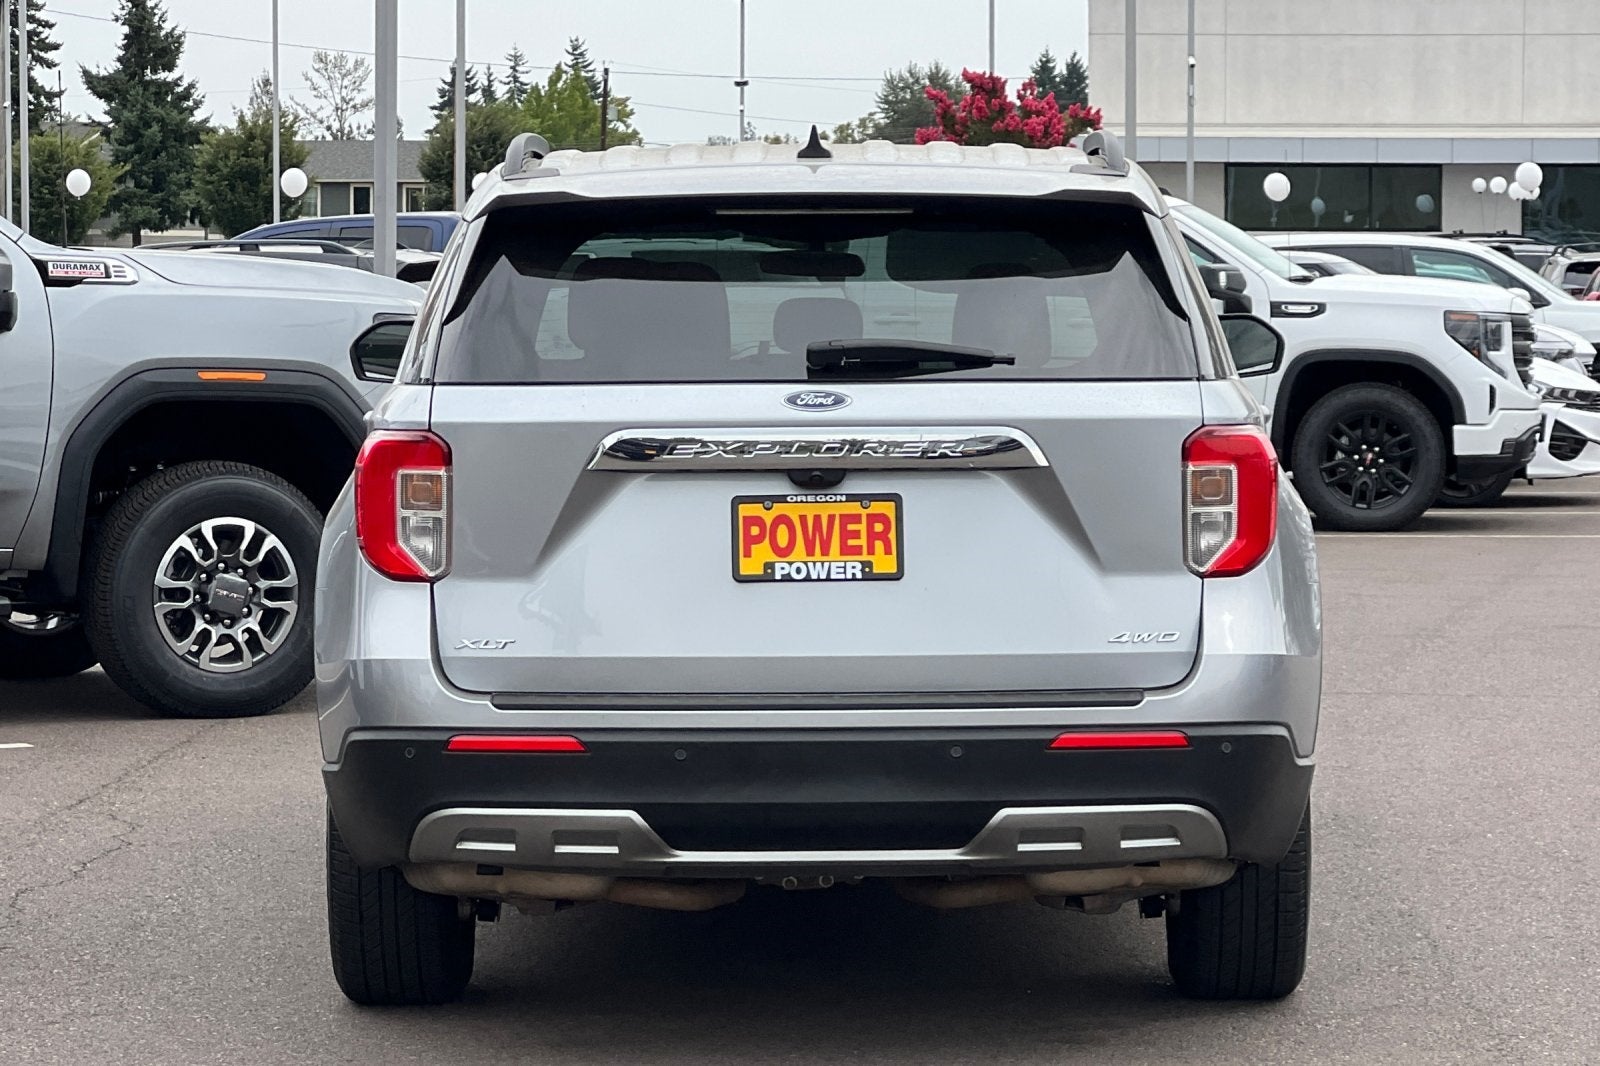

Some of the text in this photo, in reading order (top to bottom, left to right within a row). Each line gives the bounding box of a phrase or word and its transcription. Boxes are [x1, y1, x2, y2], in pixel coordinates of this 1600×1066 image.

[52, 263, 101, 271] DURAMAX
[796, 392, 836, 405] Ford
[662, 441, 964, 458] EXPLORER
[742, 513, 893, 558] POWER
[774, 562, 863, 580] POWER
[1107, 631, 1180, 643] 4WD
[454, 639, 516, 650] XLT
